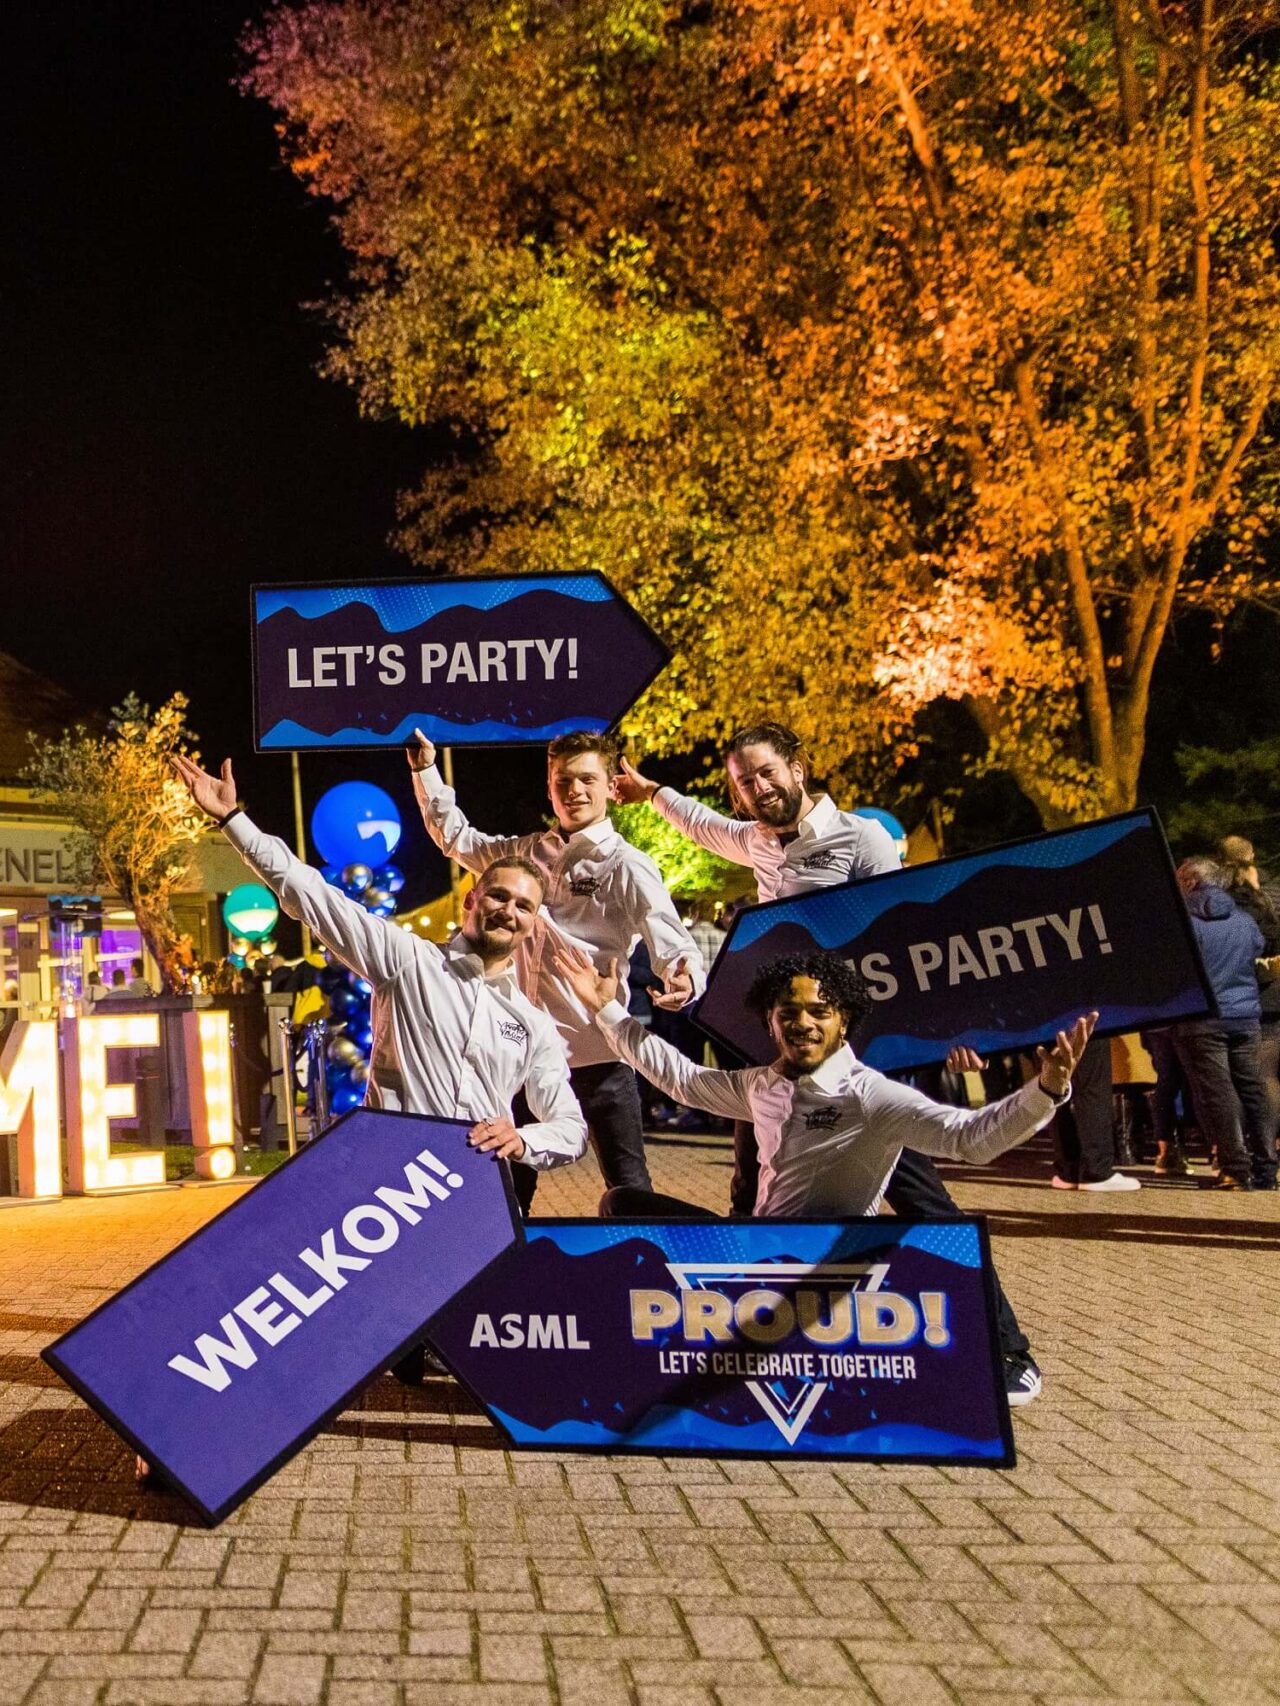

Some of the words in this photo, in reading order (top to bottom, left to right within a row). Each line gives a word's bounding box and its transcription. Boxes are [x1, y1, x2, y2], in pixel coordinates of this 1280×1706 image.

[287, 643, 407, 689] LET'S
[420, 637, 579, 685] PARTY!
[907, 903, 1113, 993] PARTY!
[166, 1149, 464, 1393] WELKOM!
[468, 1313, 591, 1350] ASML
[628, 1288, 952, 1348] PROUD!
[658, 1351, 708, 1375] LET'S
[711, 1352, 816, 1378] CELEBRATE
[821, 1353, 918, 1380] TOGETHER
